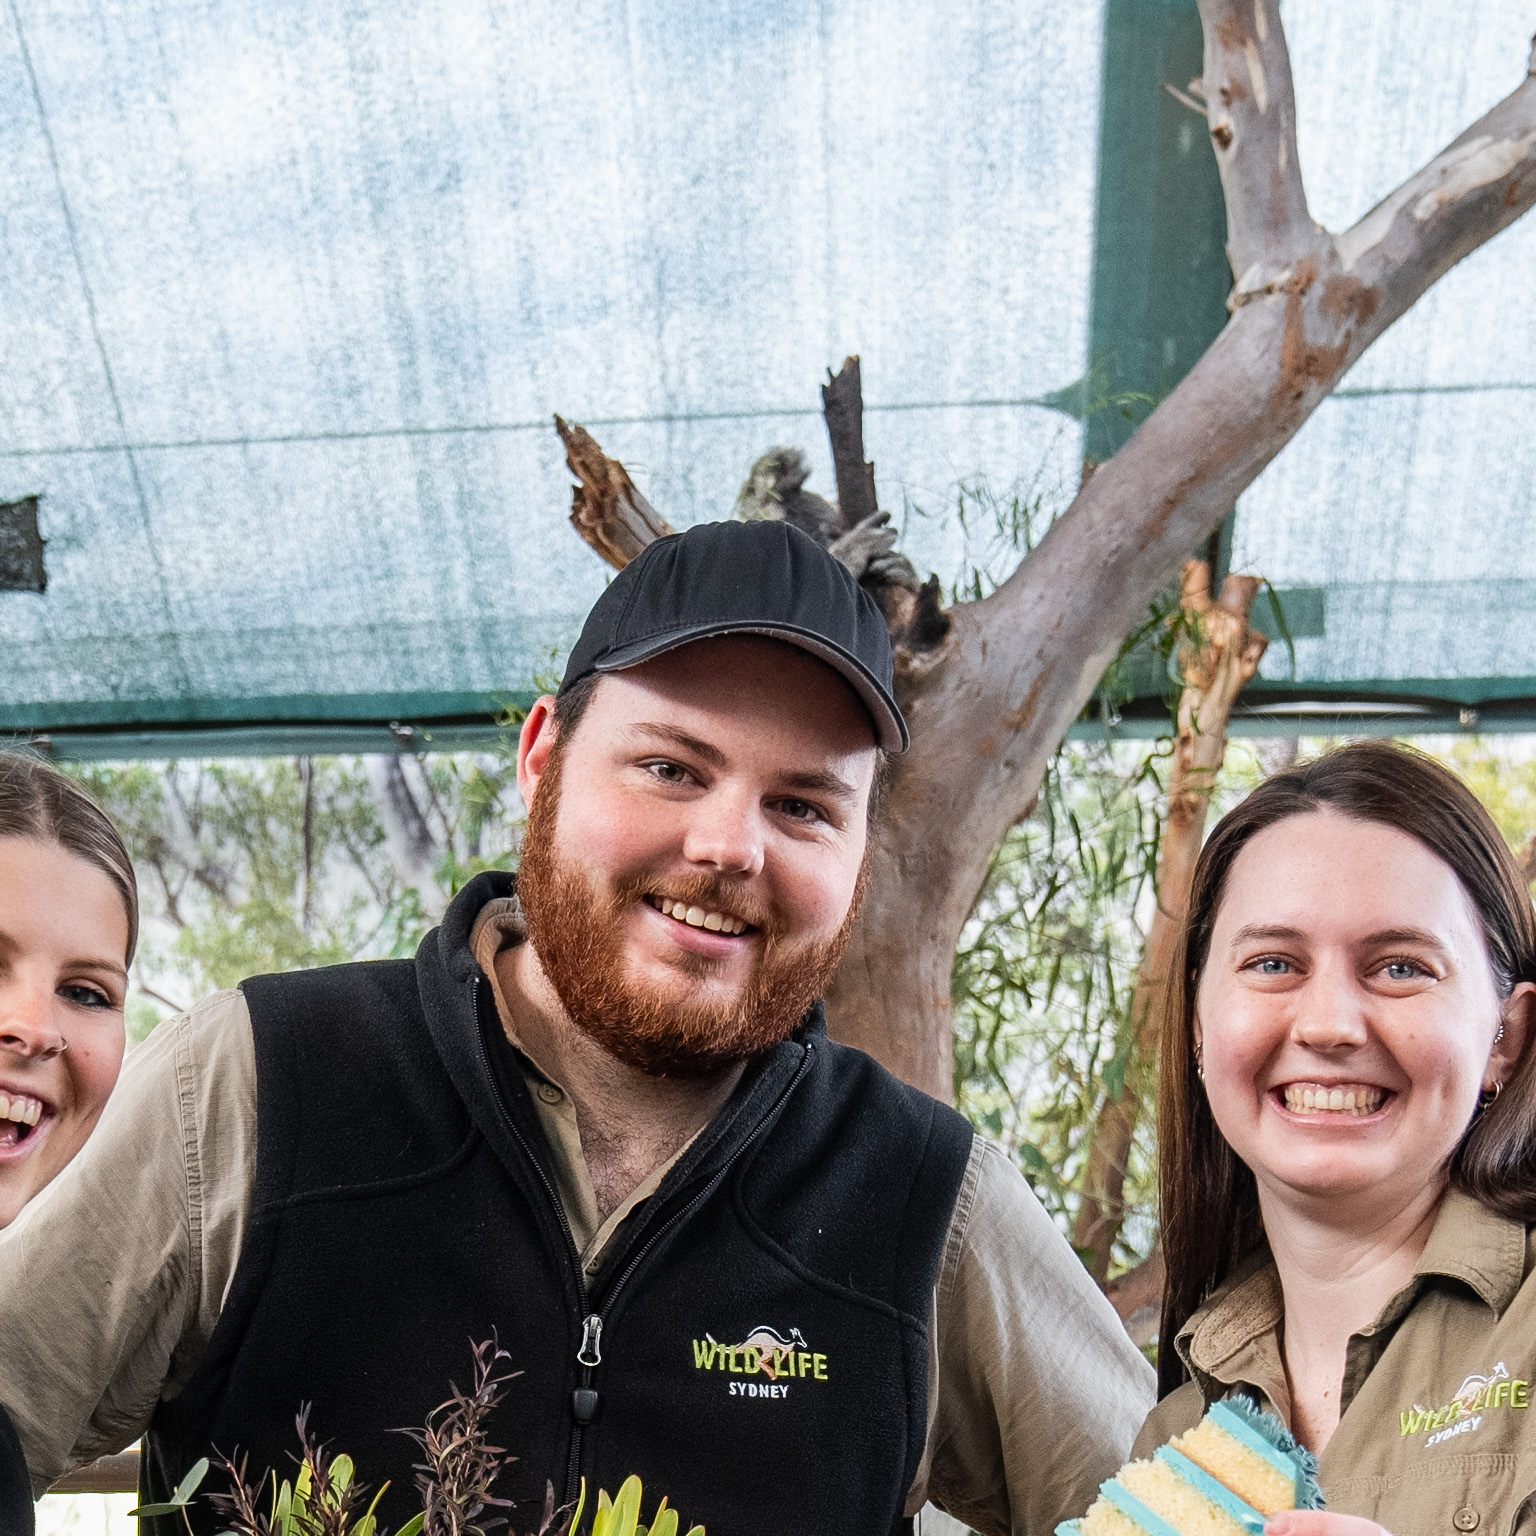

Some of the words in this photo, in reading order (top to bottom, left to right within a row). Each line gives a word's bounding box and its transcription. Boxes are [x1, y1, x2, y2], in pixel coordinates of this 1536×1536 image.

[692, 1339, 760, 1374] WILD
[773, 1349, 829, 1380] LIFE
[729, 1382, 790, 1399] SYDNEY
[1424, 1415, 1484, 1448] SYDNEY
